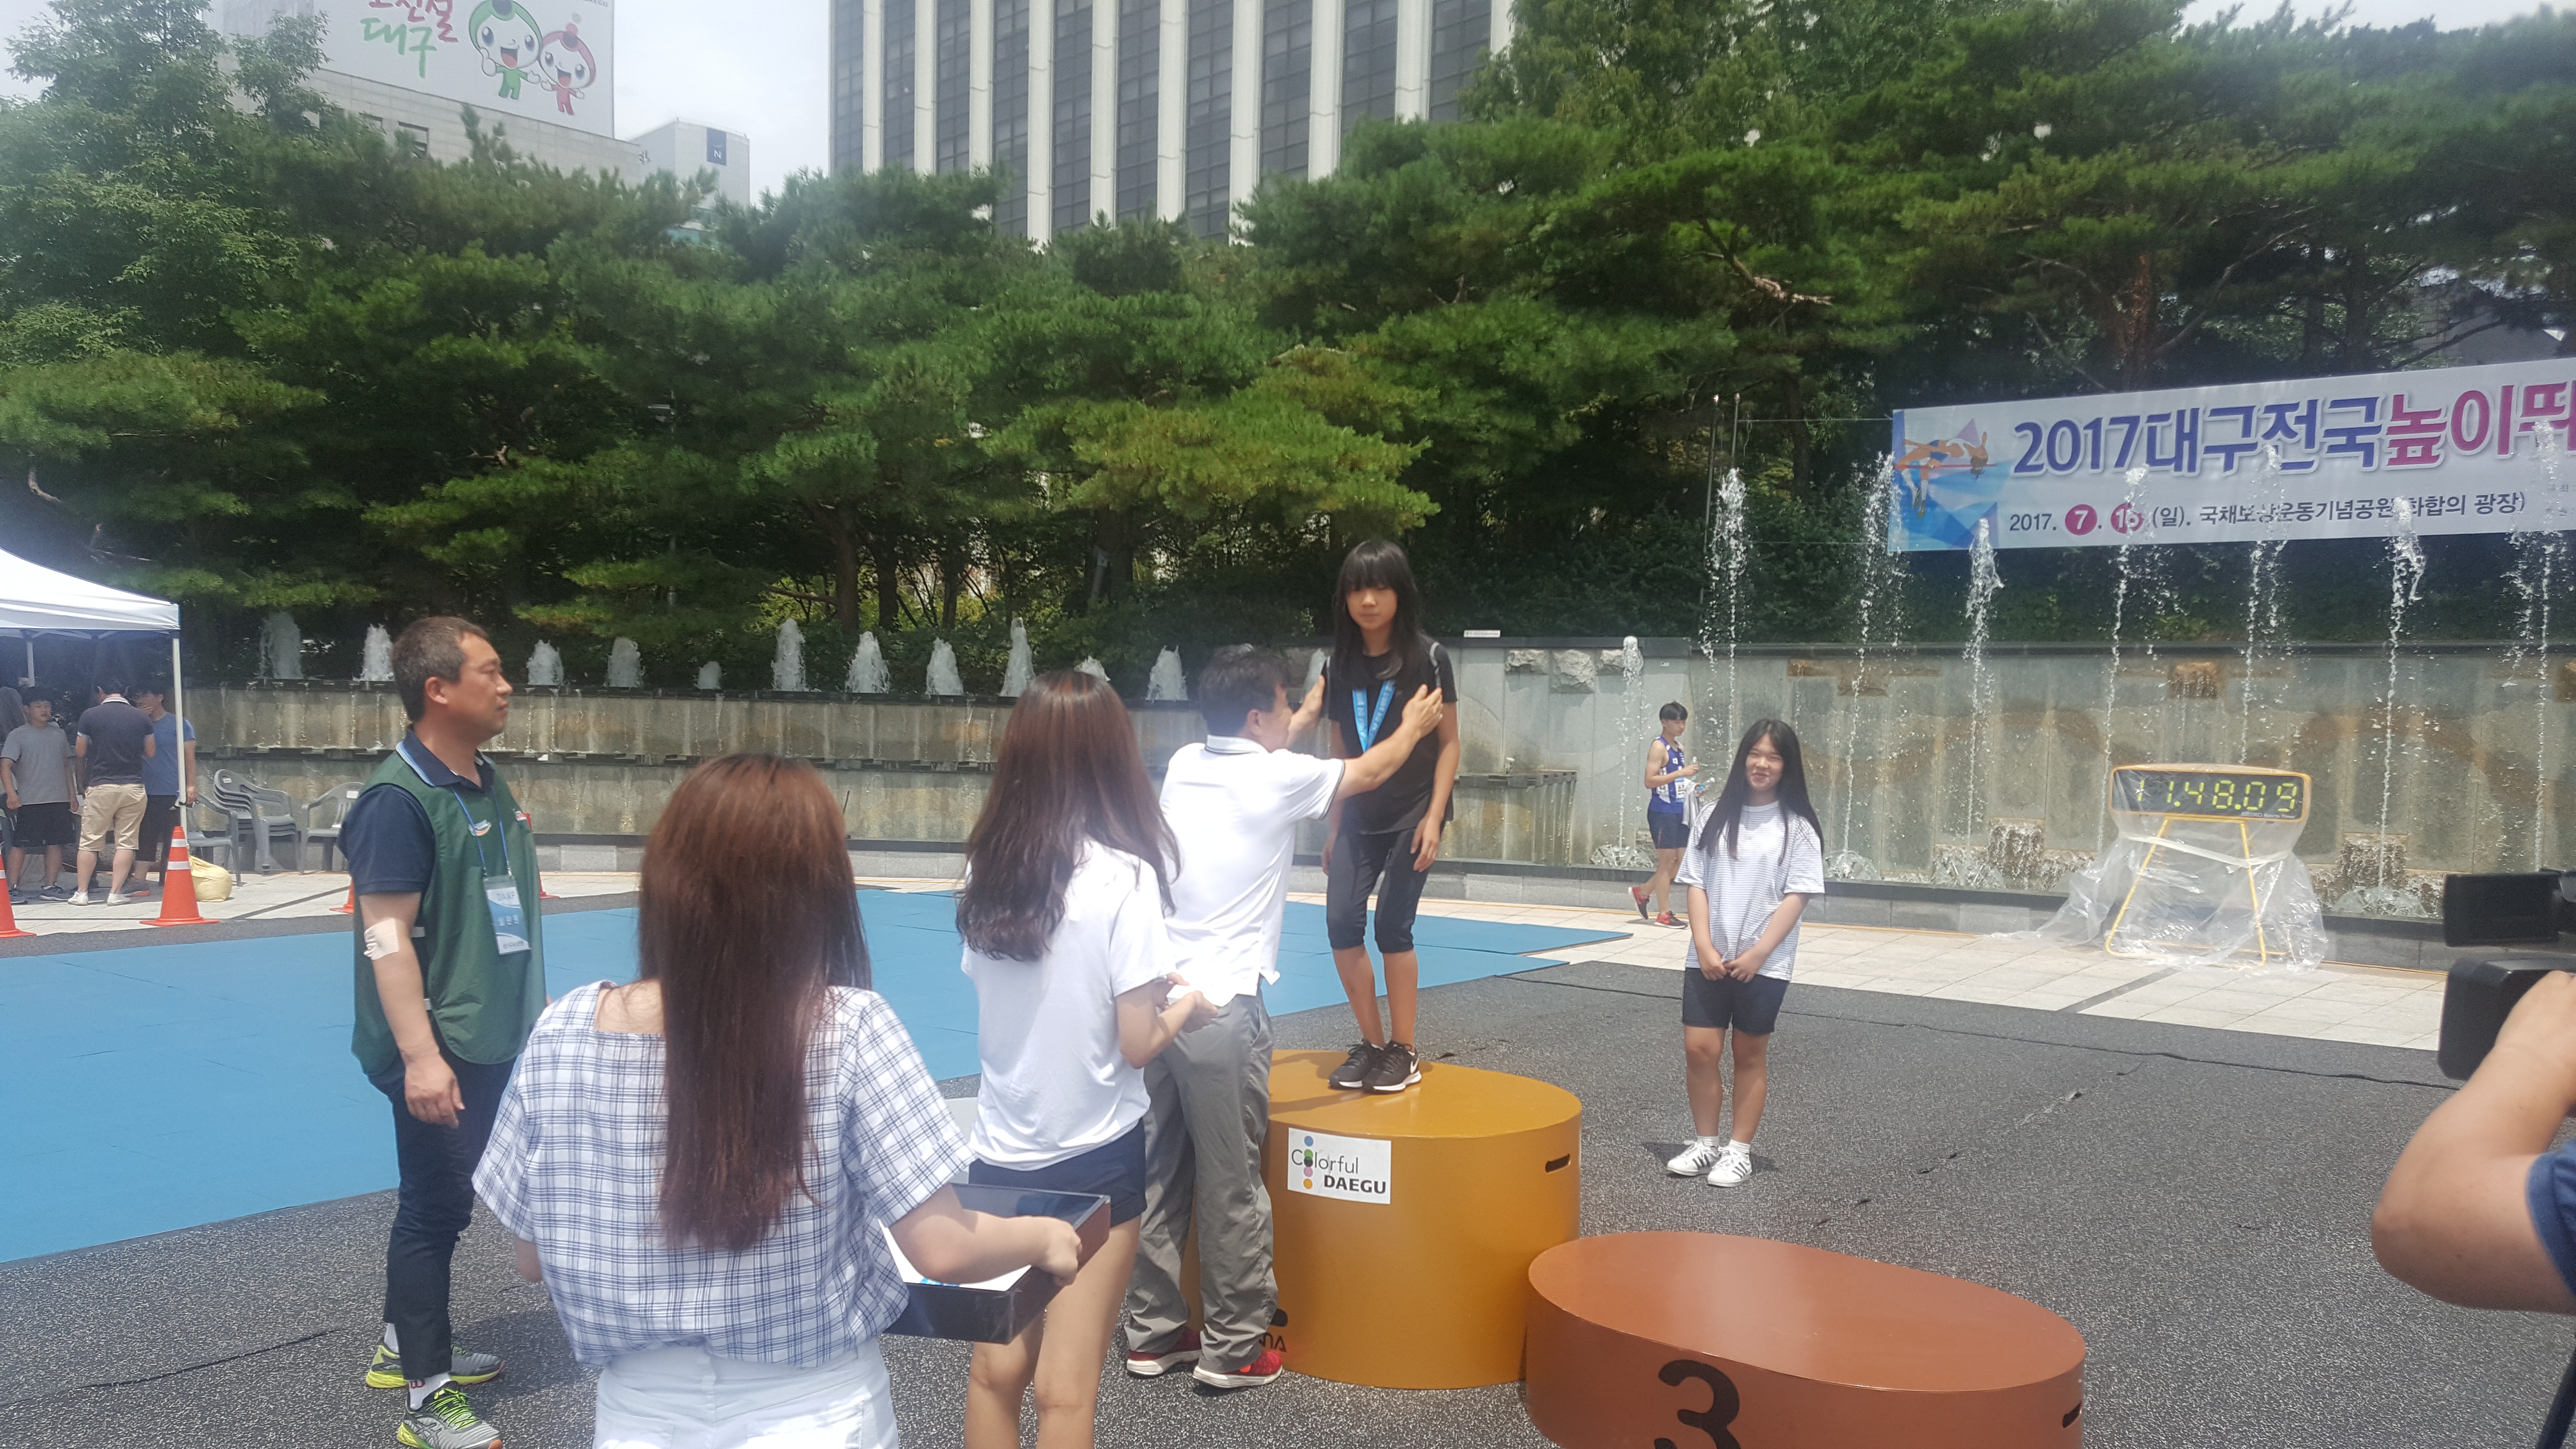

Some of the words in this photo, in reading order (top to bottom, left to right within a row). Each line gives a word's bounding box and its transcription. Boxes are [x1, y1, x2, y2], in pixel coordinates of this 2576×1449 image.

[360, 17, 437, 79] 대구
[2474, 491, 2525, 515] 광장)
[1291, 1149, 1358, 1175] Colorful
[1324, 1175, 1386, 1194] DAEGU
[1654, 1359, 1741, 1449] 3
